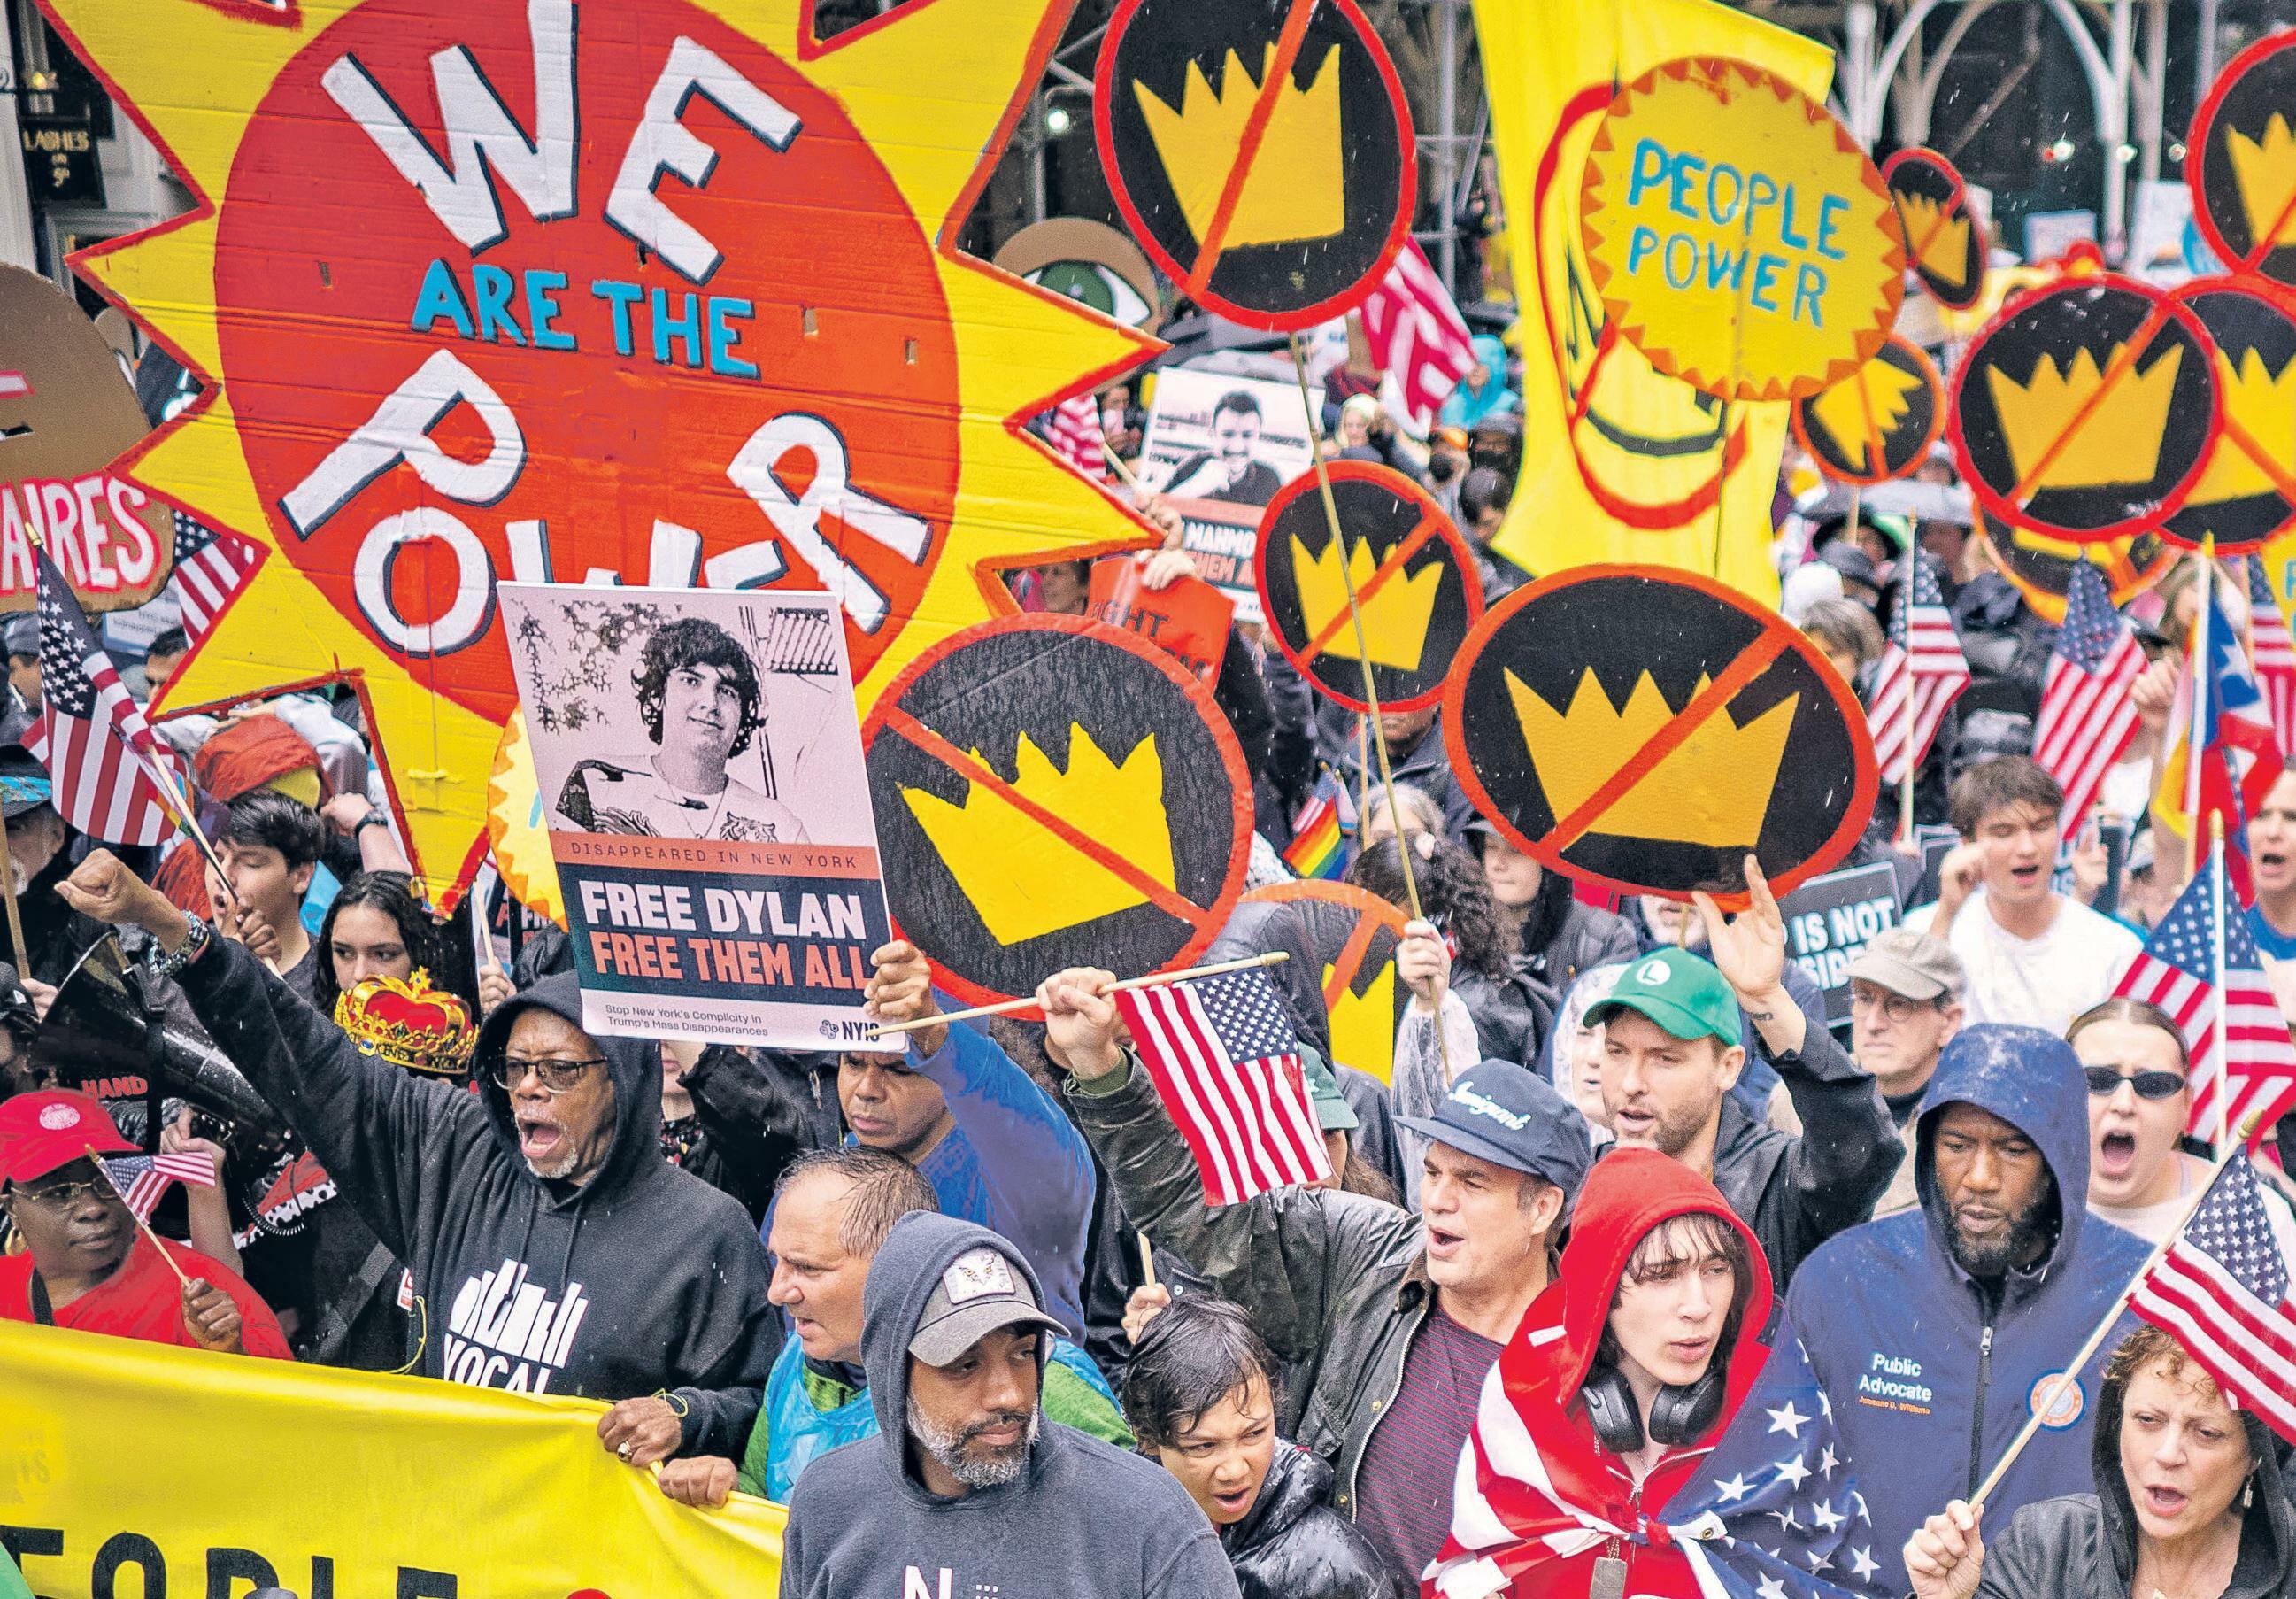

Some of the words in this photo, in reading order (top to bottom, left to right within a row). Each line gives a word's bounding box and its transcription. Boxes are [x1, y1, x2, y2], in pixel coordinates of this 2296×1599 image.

[321, 0, 803, 286] WE
[1627, 137, 1850, 260] PEOPLE
[1627, 224, 1828, 329] POWER
[410, 258, 578, 352] ARE
[592, 279, 760, 381] THE
[572, 842, 706, 862] DISAPPEARED
[719, 851, 740, 864] IN
[752, 854, 792, 866] NEW
[805, 855, 857, 869] YORK
[579, 880, 697, 931] FREE
[704, 888, 867, 940] DYLAN
[1791, 911, 1829, 954] IS
[1829, 895, 1895, 947] NOT
[589, 931, 683, 980] FREE
[688, 937, 794, 986] THEM
[805, 944, 876, 991] ALL
[605, 1004, 630, 1016] Stop
[632, 1007, 655, 1016] New
[658, 1008, 690, 1019] York's
[692, 1011, 749, 1025] Complicity
[751, 1014, 762, 1024] in
[608, 1016, 651, 1029] Trump's
[652, 1020, 680, 1031] Mass
[682, 1022, 768, 1036] Disappearances
[81, 1076, 149, 1101] HAND
[1858, 1373, 1933, 1402] Advocate
[1871, 1352, 1922, 1378] Public
